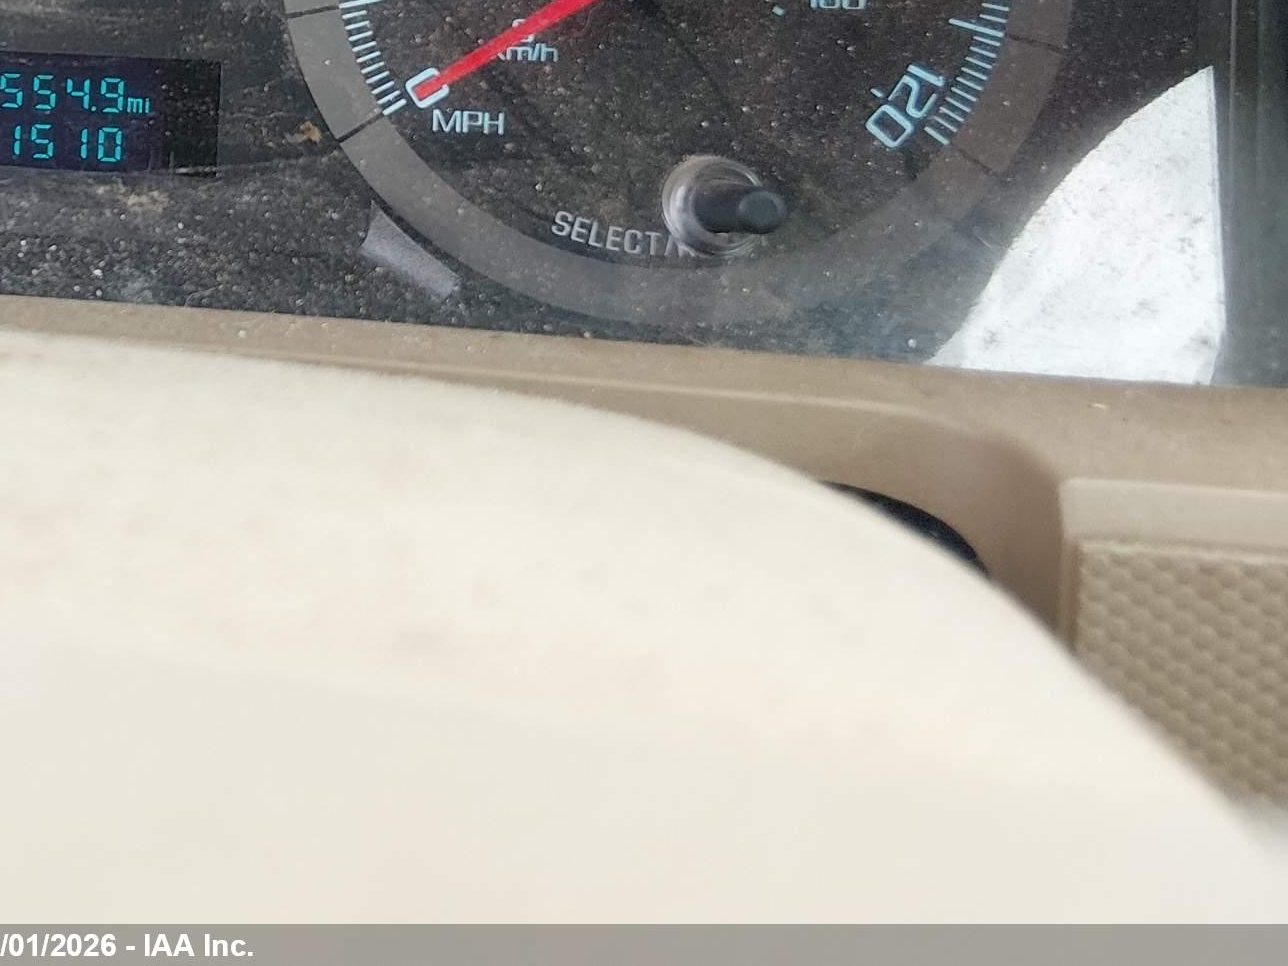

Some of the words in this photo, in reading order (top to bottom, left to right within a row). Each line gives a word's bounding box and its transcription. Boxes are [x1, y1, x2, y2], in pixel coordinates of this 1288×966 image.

[126, 96, 151, 115] mi
[864, 64, 946, 148] 120
[432, 108, 505, 135] MPH
